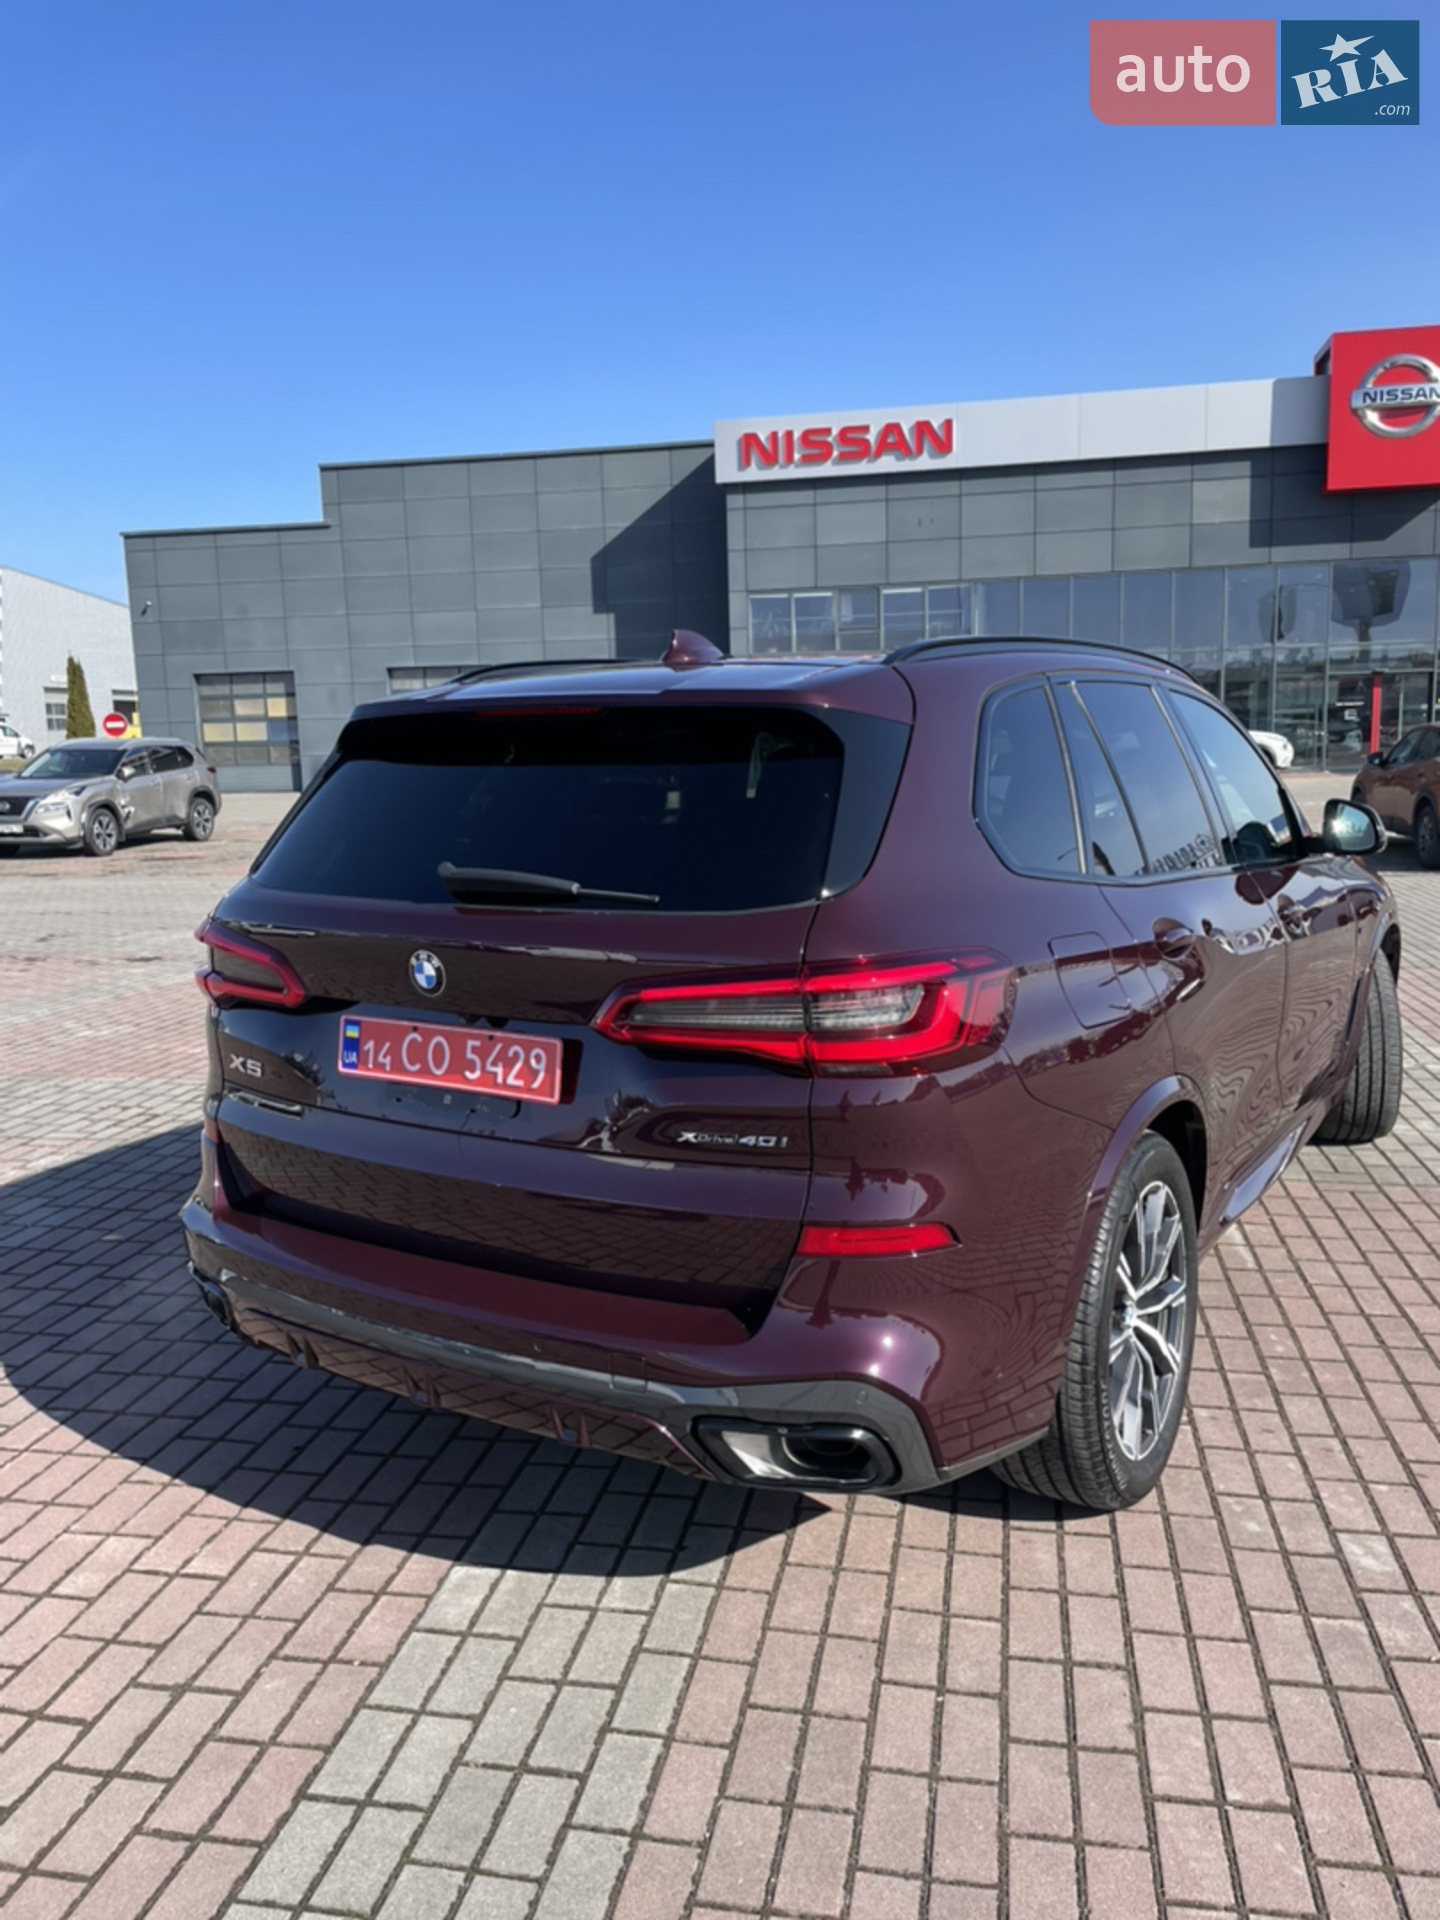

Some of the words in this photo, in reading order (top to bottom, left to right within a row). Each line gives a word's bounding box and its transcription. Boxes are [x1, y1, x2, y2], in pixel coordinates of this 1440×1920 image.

[1362, 386, 1440, 404] NISSAN
[739, 418, 954, 468] NISSAN
[229, 1053, 262, 1078] X5
[343, 1050, 358, 1064] UA
[363, 1039, 391, 1071] 14
[401, 1032, 450, 1076] CO
[464, 1039, 547, 1089] 5429
